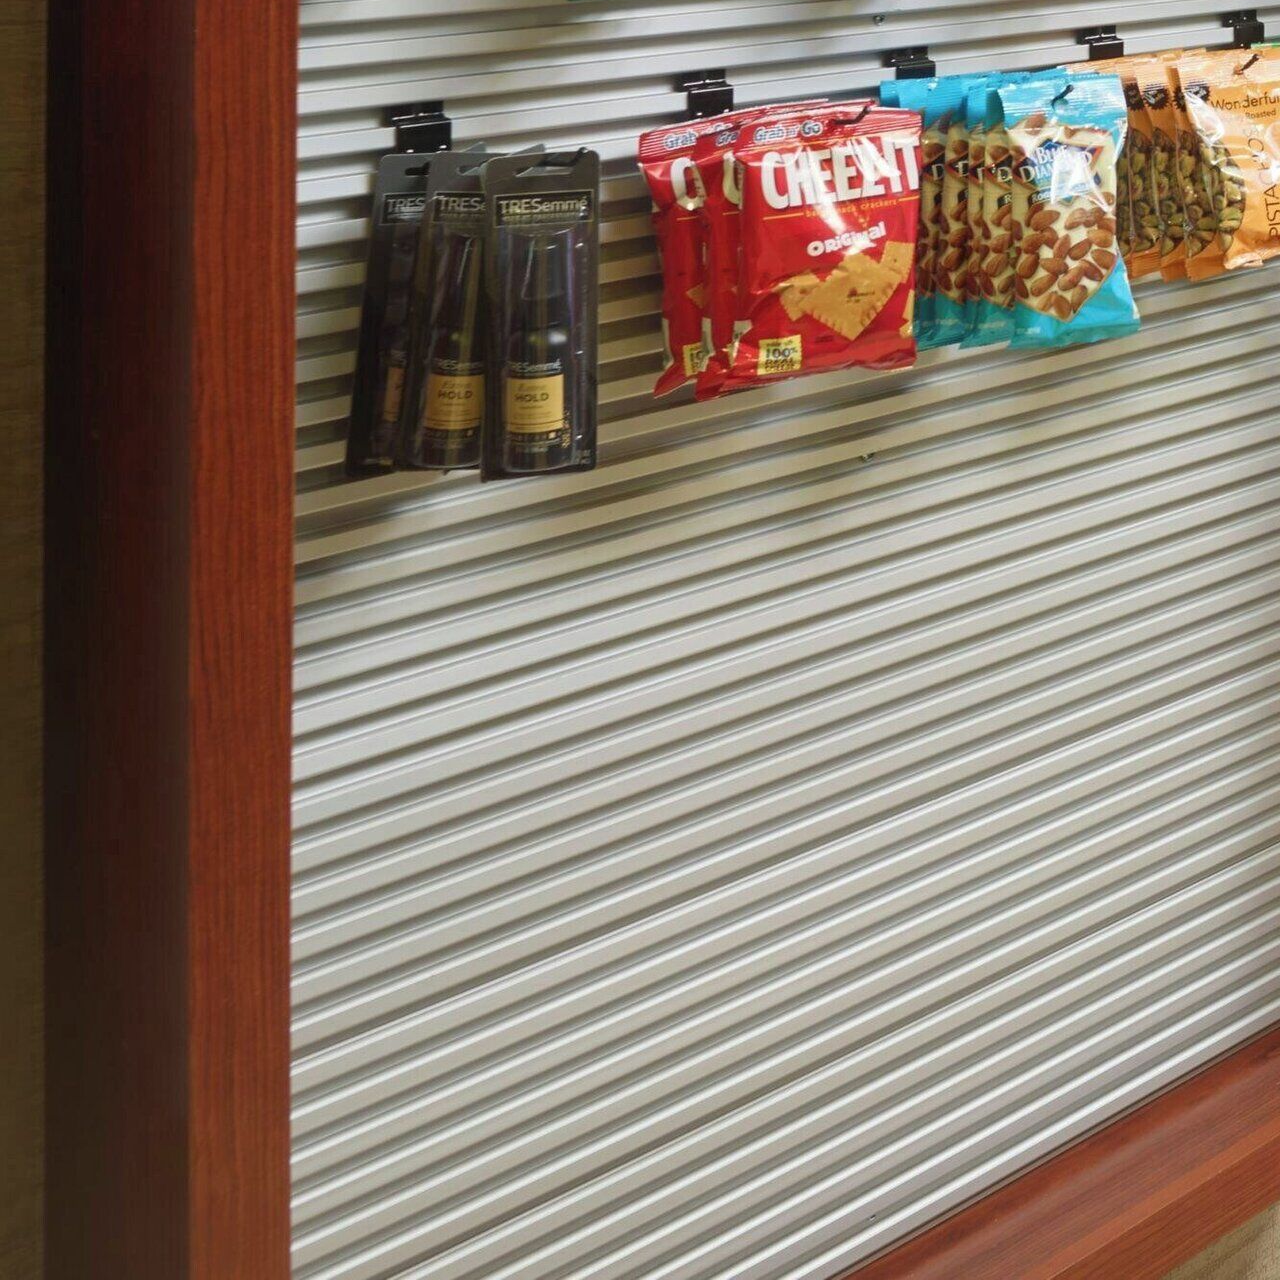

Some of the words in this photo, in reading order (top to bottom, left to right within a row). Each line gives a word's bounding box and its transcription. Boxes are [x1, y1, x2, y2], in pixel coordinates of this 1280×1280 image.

[1211, 94, 1280, 113] Wonderful
[664, 131, 697, 150] Grab
[754, 128, 786, 144] Grab
[801, 121, 822, 136] Go
[499, 195, 589, 214] TRESemmé
[437, 389, 473, 401] HOLD
[514, 391, 549, 403] HOLD
